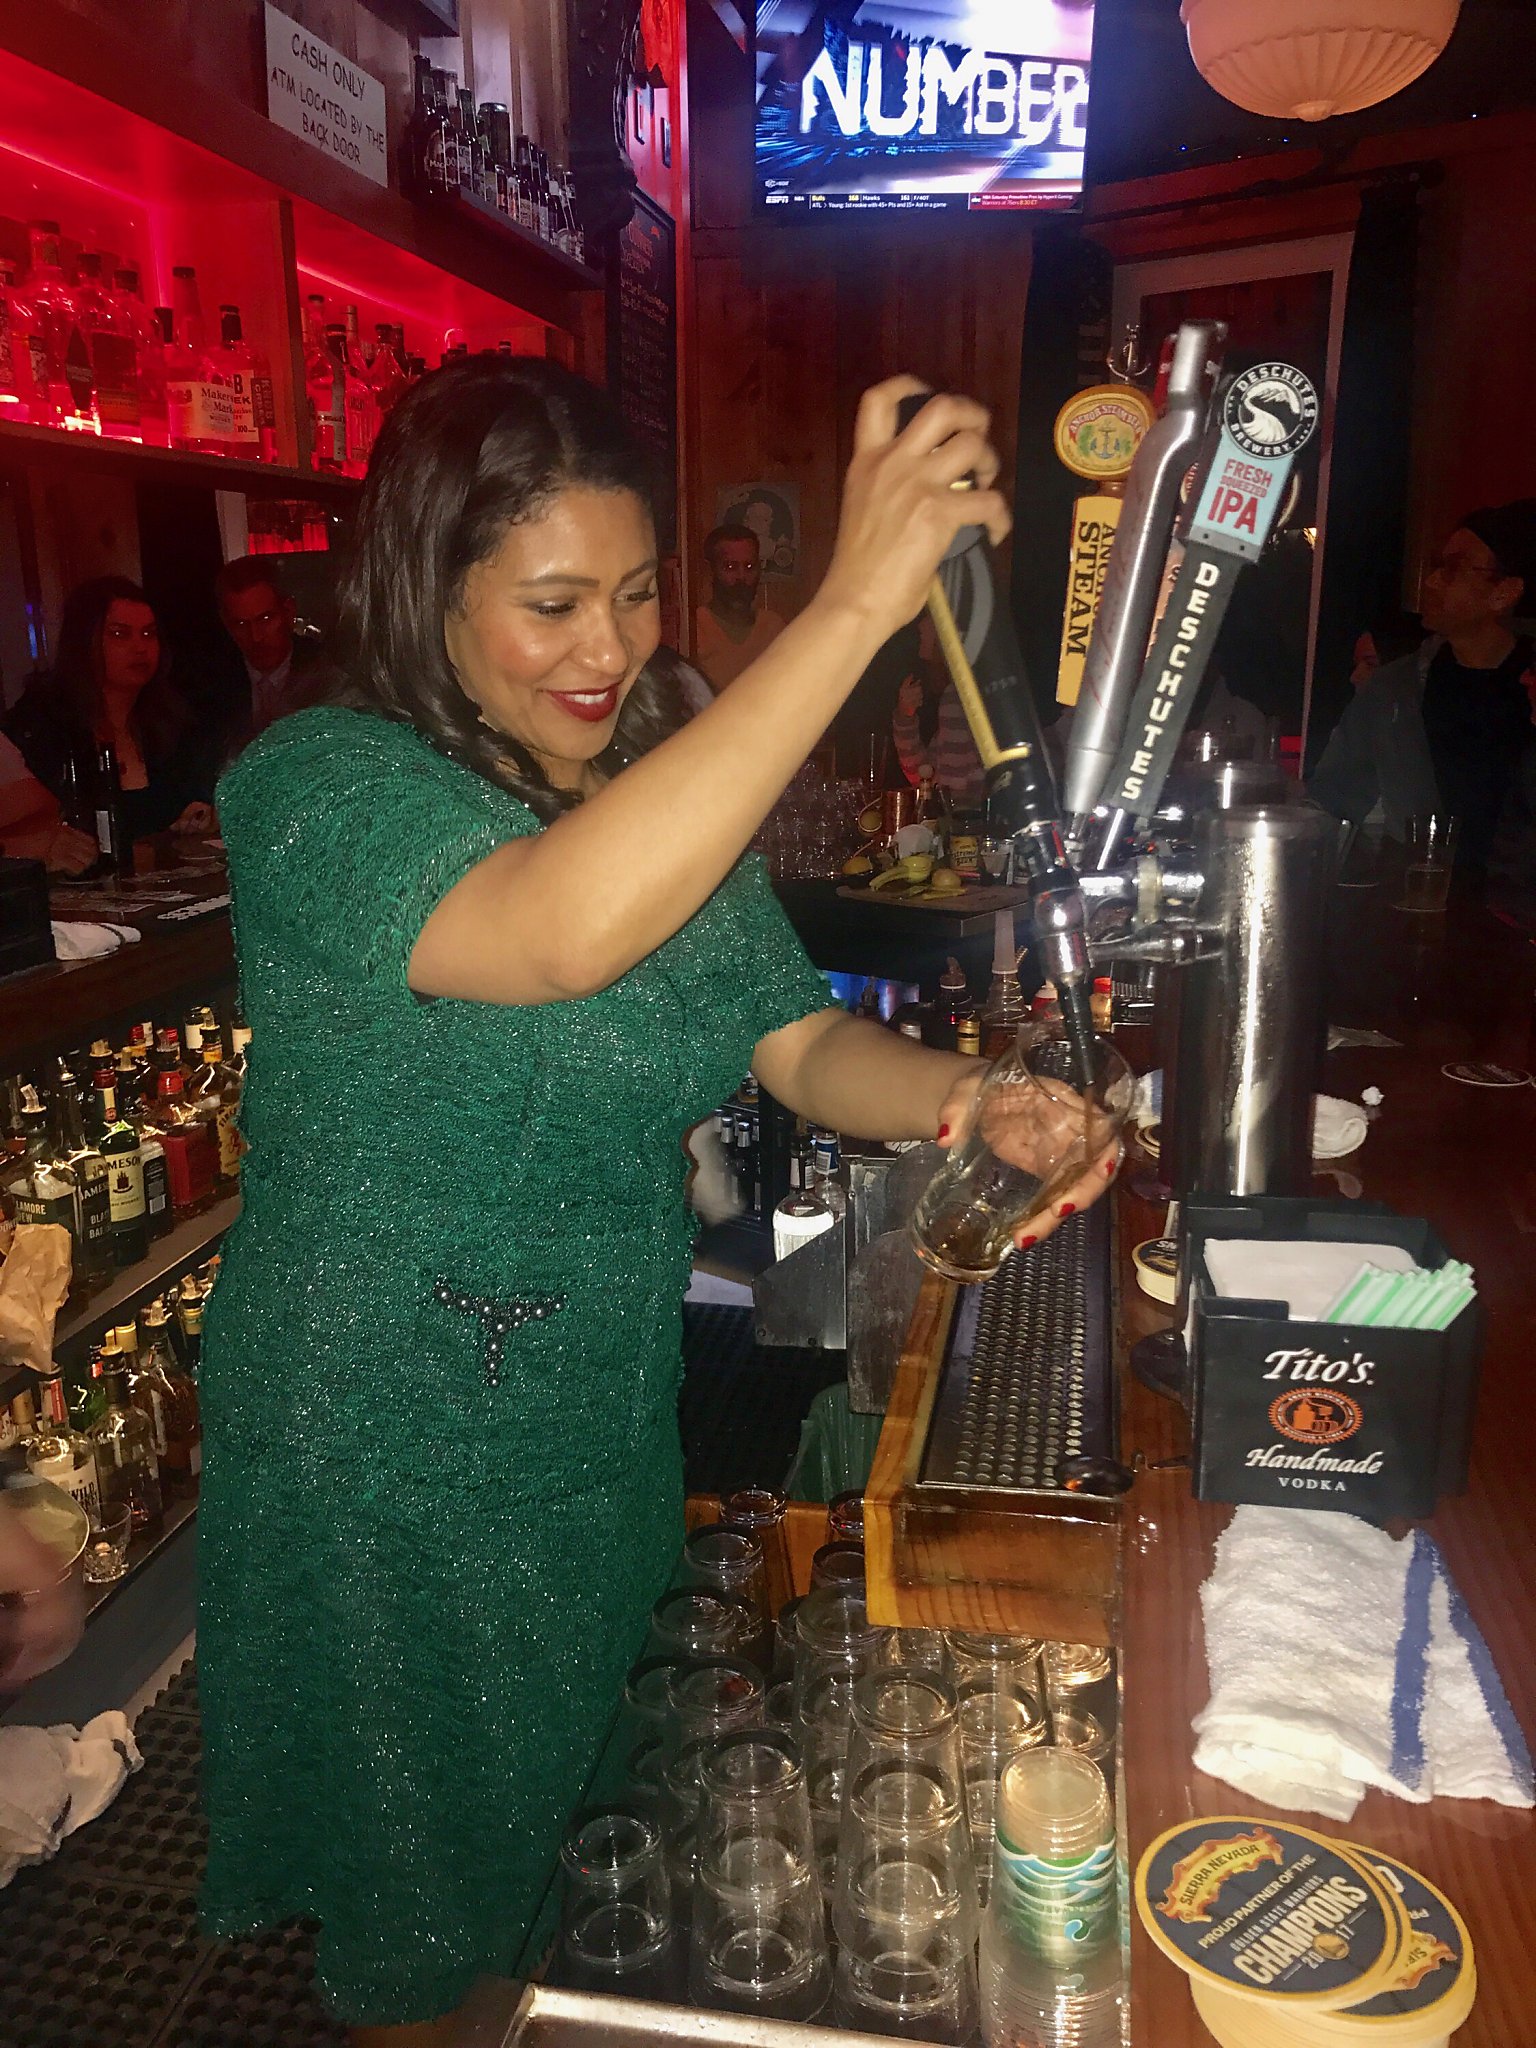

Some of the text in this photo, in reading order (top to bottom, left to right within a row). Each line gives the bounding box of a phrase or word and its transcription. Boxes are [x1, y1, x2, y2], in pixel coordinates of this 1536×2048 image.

[291, 33, 366, 101] CASH ONLY
[271, 67, 384, 153] ATM LOCATED BY THE
[302, 112, 361, 164] BACK DOOR
[765, 195, 789, 204] ESPN
[1236, 366, 1317, 418] DESCHUTES
[1230, 423, 1291, 456] BREWERY
[1223, 458, 1273, 488] FRESH
[1207, 486, 1259, 534] IPA
[1066, 521, 1101, 657] STEAM
[1121, 562, 1221, 800] DESCHUTES
[1262, 1347, 1375, 1386] Tito's
[1245, 1444, 1384, 1475] Handmade
[1278, 1477, 1347, 1492] VODKA
[1179, 1843, 1260, 1906] SIERRA NEVADA
[1198, 1853, 1317, 1949] PROUD PARTNER OF THE
[1229, 1874, 1325, 1952] GOLDEN STATE WARRIORS
[1233, 1875, 1368, 1985] CHAMPIONS
[1302, 1925, 1356, 1970] 20 17
